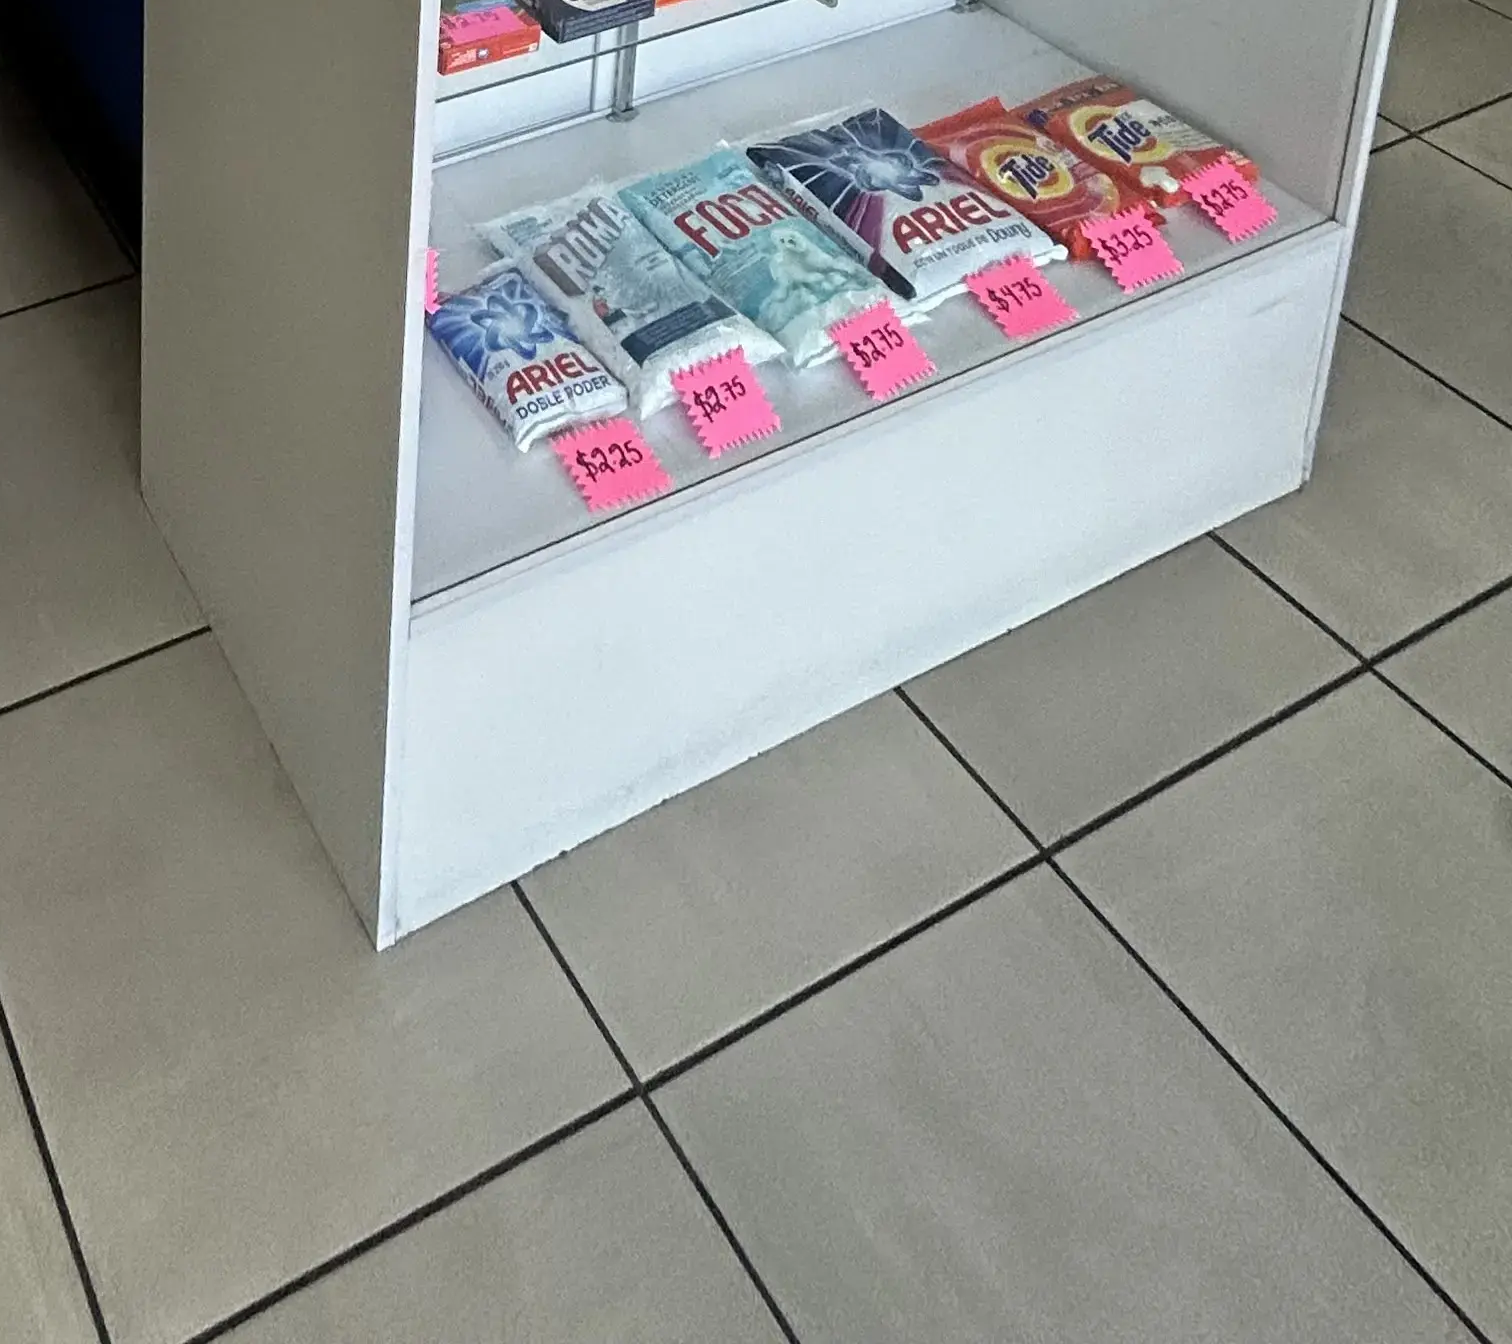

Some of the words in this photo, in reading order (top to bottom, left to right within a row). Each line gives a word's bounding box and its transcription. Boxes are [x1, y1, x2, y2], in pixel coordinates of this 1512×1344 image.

[1088, 115, 1151, 164] Tide
[999, 153, 1055, 200] Tide
[1200, 179, 1248, 216] $2.75
[674, 184, 795, 259] FOCA
[893, 191, 1011, 254] ARIEL
[986, 222, 1032, 244] Downy
[543, 197, 630, 296] ROMA
[1098, 224, 1153, 265] $3.25
[986, 277, 1042, 312] $4.75
[850, 323, 904, 367] $2.75
[506, 352, 599, 405] ARIEL
[693, 375, 746, 423] $2.75
[516, 391, 564, 420] DOBLE
[576, 440, 643, 482] $2.25
